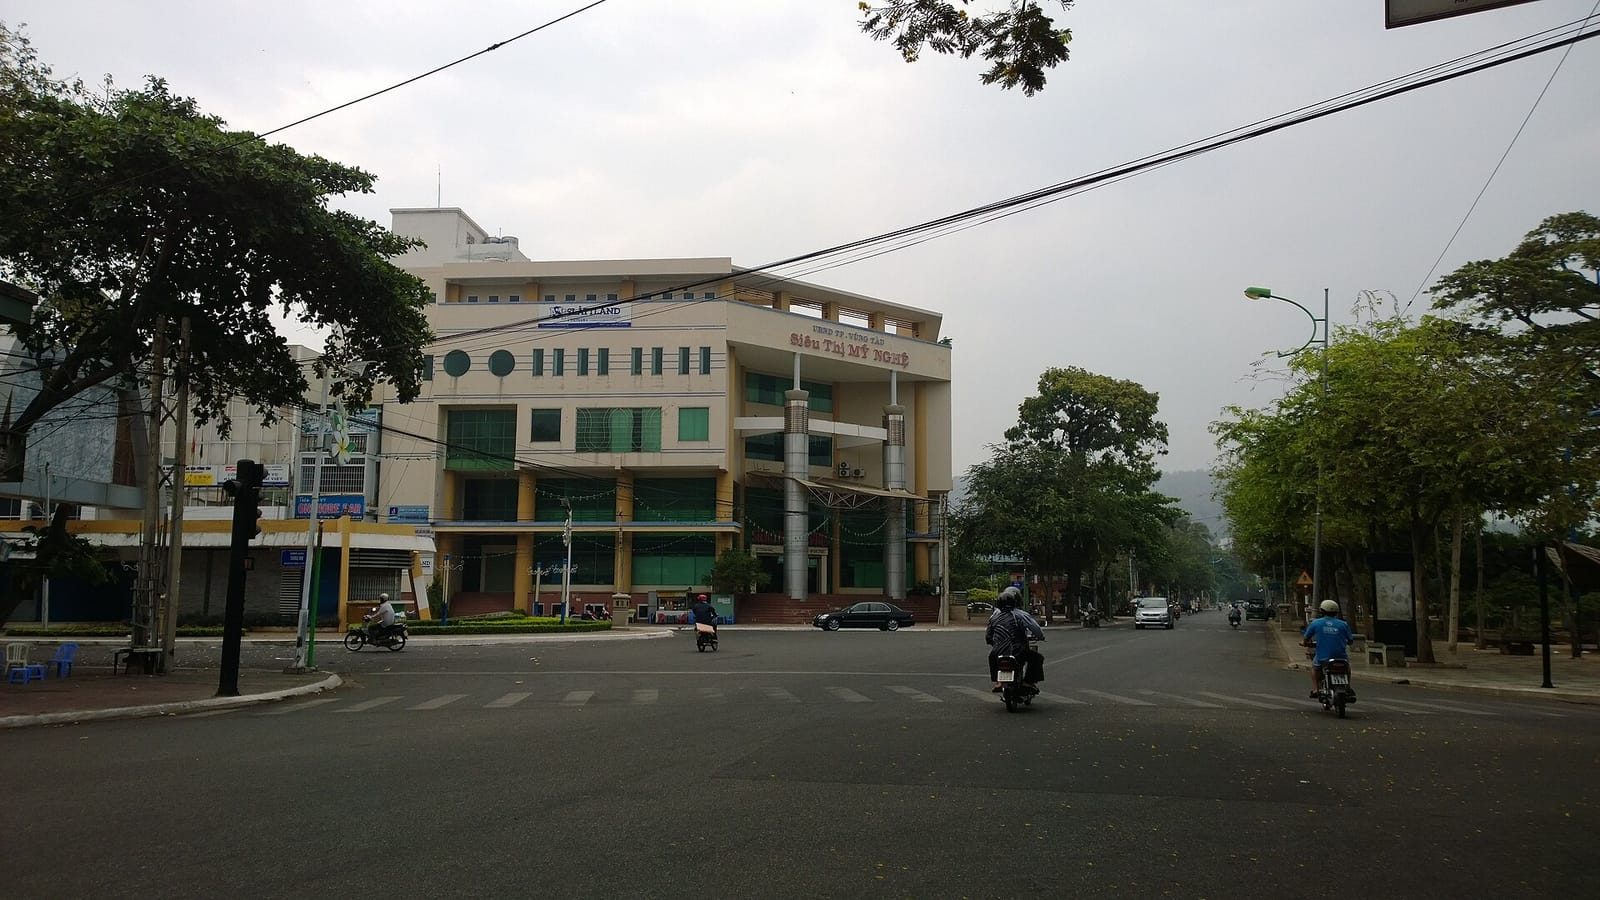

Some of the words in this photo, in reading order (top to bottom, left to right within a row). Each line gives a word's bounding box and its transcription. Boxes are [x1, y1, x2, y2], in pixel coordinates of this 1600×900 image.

[790, 333, 820, 350] Siêu
[823, 339, 845, 357] Thị
[873, 349, 909, 368] NGHỆ
